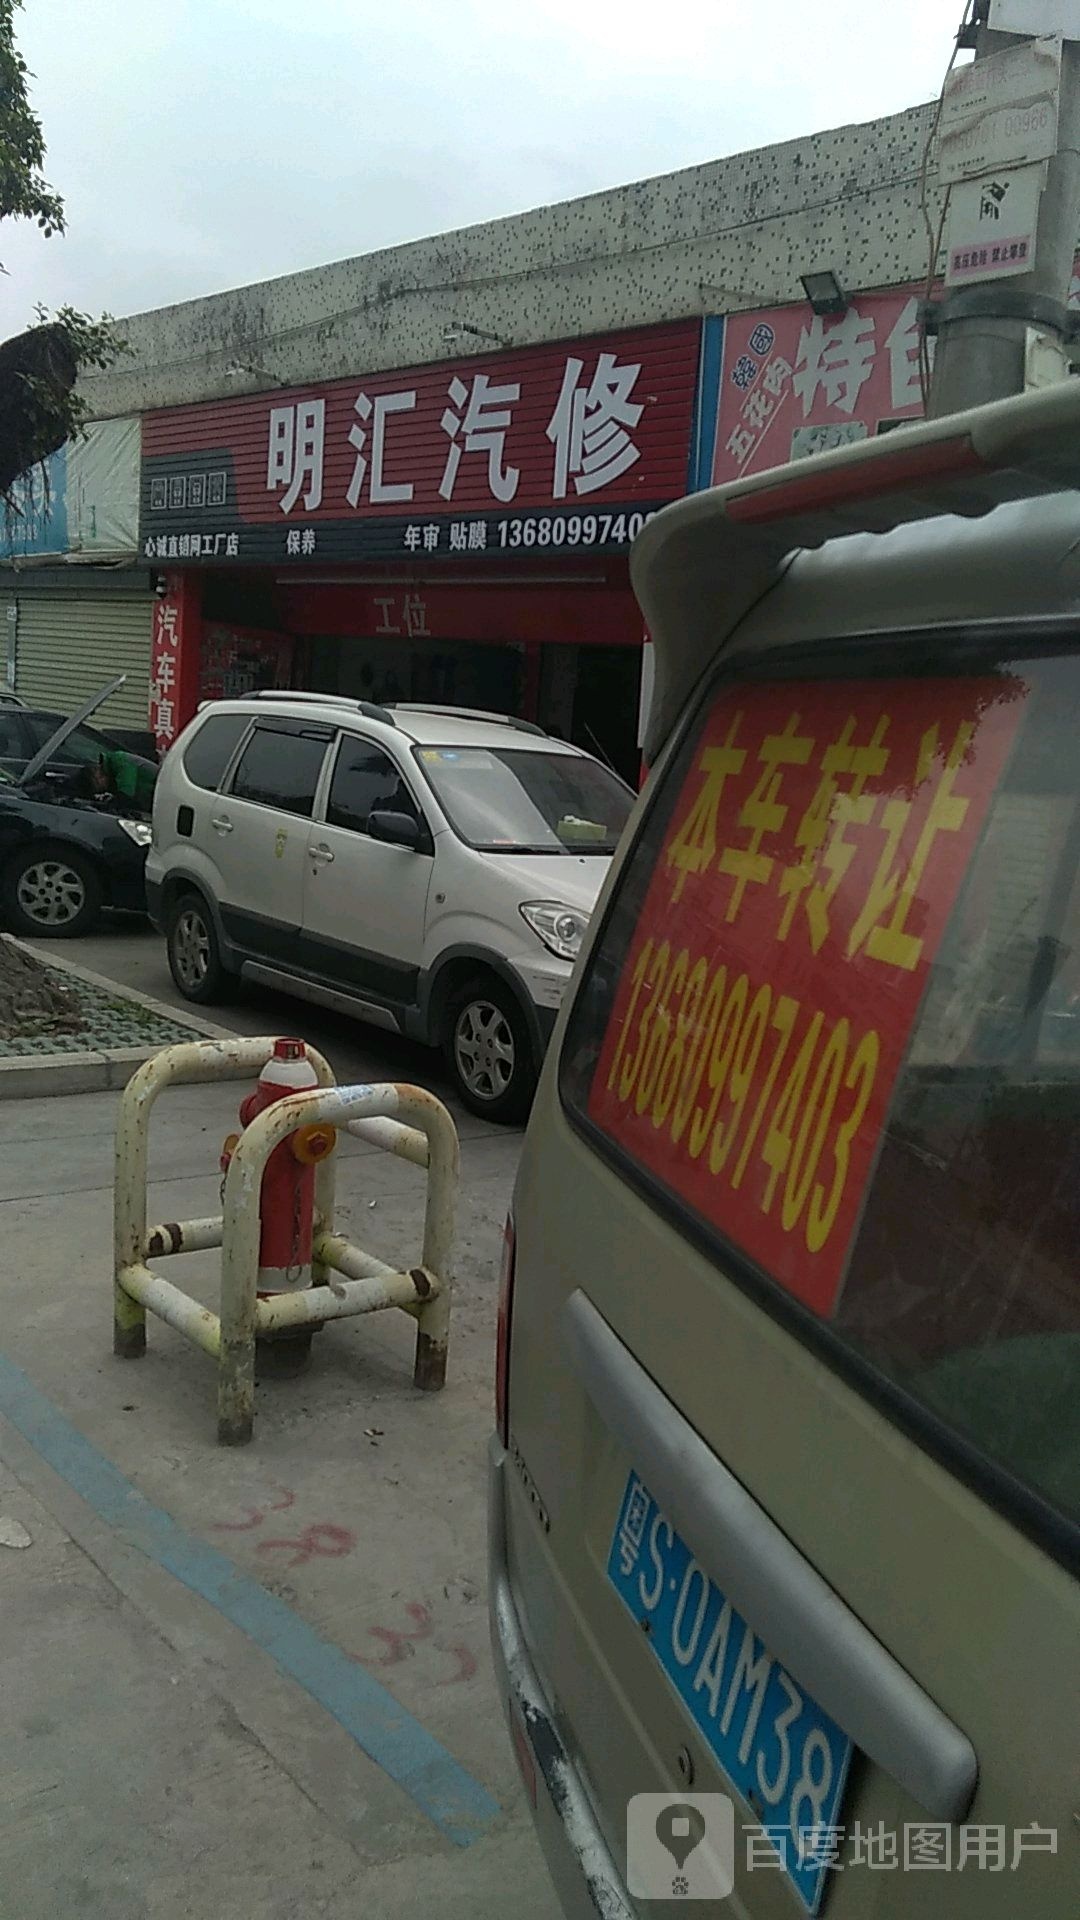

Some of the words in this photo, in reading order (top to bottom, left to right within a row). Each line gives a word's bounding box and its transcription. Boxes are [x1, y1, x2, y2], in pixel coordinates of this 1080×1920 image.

[266, 353, 646, 515] 明汇汽修
[286, 528, 316, 555] 保养
[403, 524, 440, 552] 年审
[449, 521, 488, 551] 贴膜
[497, 511, 655, 548] 1368099740
[153, 604, 178, 758] 汽车真
[373, 593, 432, 638] 工位
[667, 709, 972, 973] 本车转让
[607, 937, 882, 1254] 13680997403
